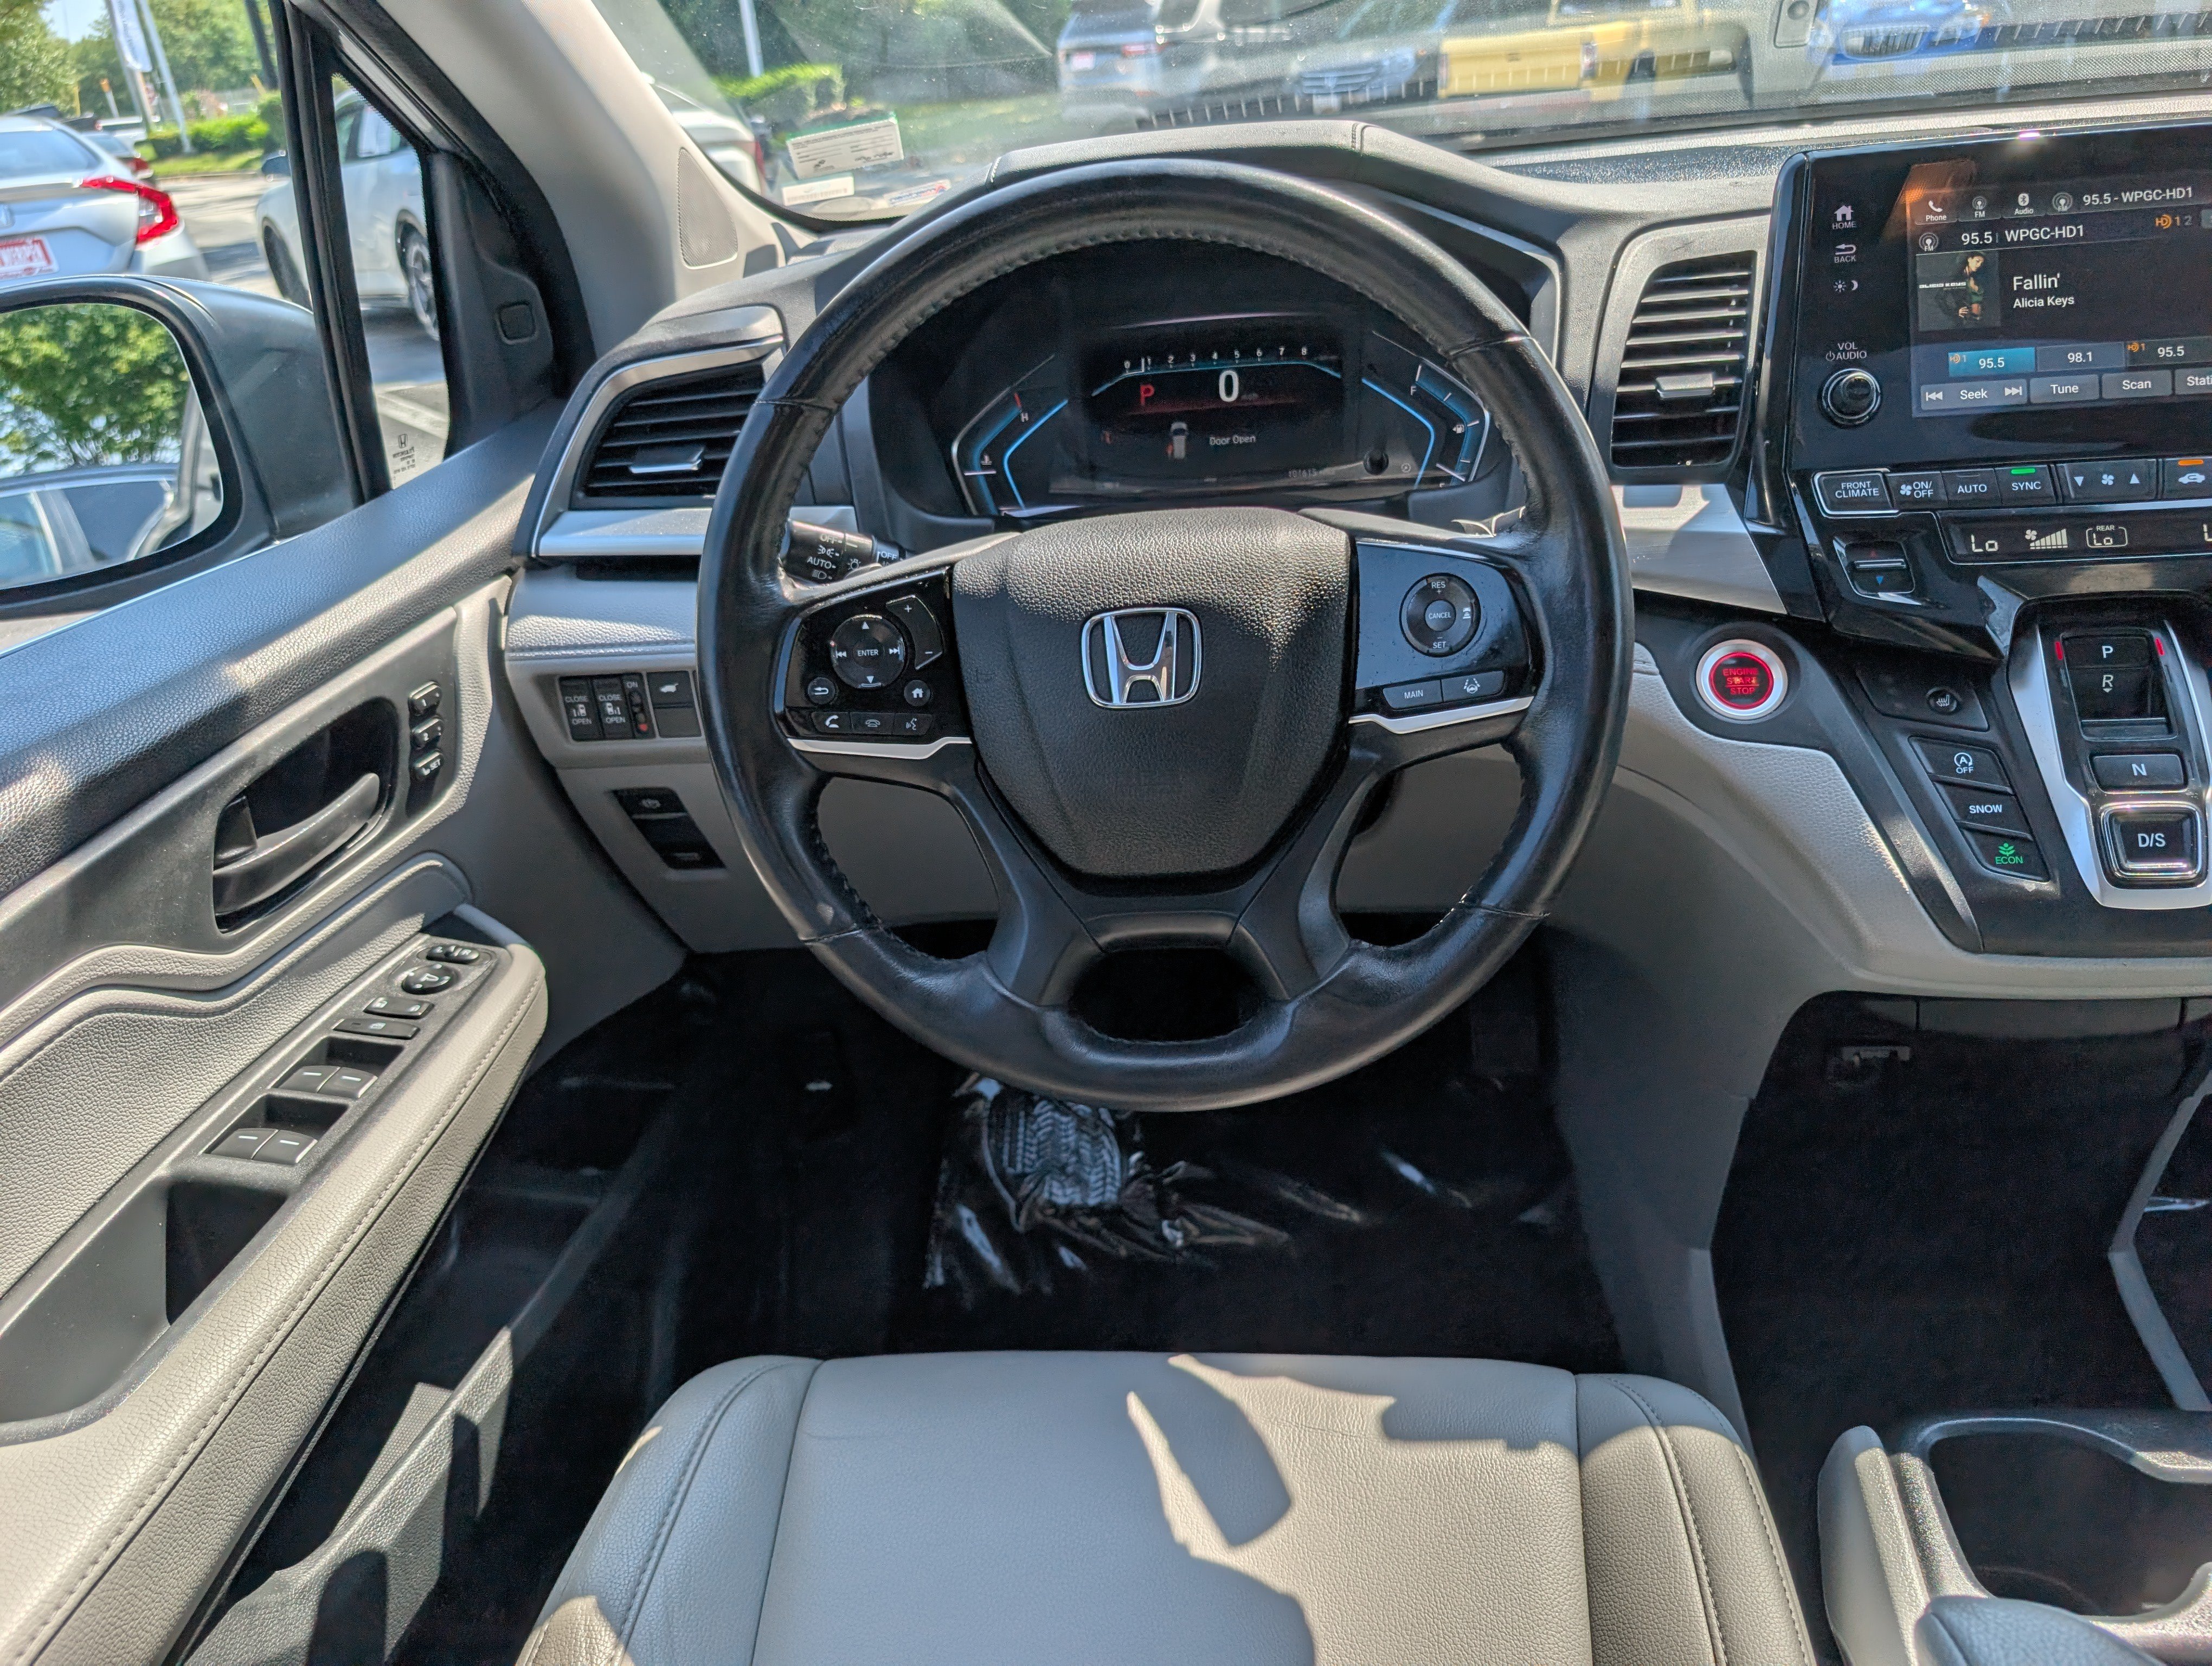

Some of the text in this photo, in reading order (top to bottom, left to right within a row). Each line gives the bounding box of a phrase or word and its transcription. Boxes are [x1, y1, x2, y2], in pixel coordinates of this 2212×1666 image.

[2083, 193, 2111, 206] 95.5
[2121, 186, 2192, 203] WPGC-HD1
[1832, 221, 1856, 230] HOME
[1961, 225, 2084, 245] 95.5 WPGC-HD1
[1834, 255, 1856, 263] BACK
[2013, 273, 2060, 291] Fallin'
[2013, 296, 2075, 309] Alicia Keys
[1837, 342, 1858, 350] VOL
[2158, 345, 2185, 357] 95.5
[1168, 354, 1174, 364] 2
[1190, 353, 1196, 362] 3
[1234, 349, 1240, 358] 5
[1256, 348, 1263, 356] 6
[1301, 347, 1308, 356] 8
[1836, 350, 1867, 360] AUDIO
[2067, 351, 2092, 363] 98.1
[1979, 357, 2005, 369] 95.5
[1219, 370, 1239, 402] 0
[2050, 385, 2079, 394] Tune
[2122, 380, 2152, 390] Scan
[1140, 383, 1155, 406] P
[1410, 386, 1417, 395] F
[1960, 388, 1988, 400] Seek
[1209, 434, 1256, 446] Door Open
[1841, 480, 1872, 490] FRONT
[1913, 480, 1932, 489] ON/
[1957, 484, 1987, 494] AUTO
[2011, 481, 2041, 491] SYNC
[1835, 488, 1879, 498] CLIMATE
[1913, 489, 1934, 498] OFF
[820, 534, 838, 544] OFF
[881, 551, 897, 560] OFF
[807, 556, 832, 569] AUTO
[857, 648, 879, 657] ENTER
[2102, 645, 2114, 658] P
[1723, 668, 1759, 676] ENGINE
[2102, 674, 2114, 688] R
[1404, 689, 1423, 699] MAIN
[2131, 764, 2147, 776] N
[1969, 804, 2002, 813] SNOW
[2137, 832, 2166, 848] D/S
[1995, 856, 2024, 864] ECON
